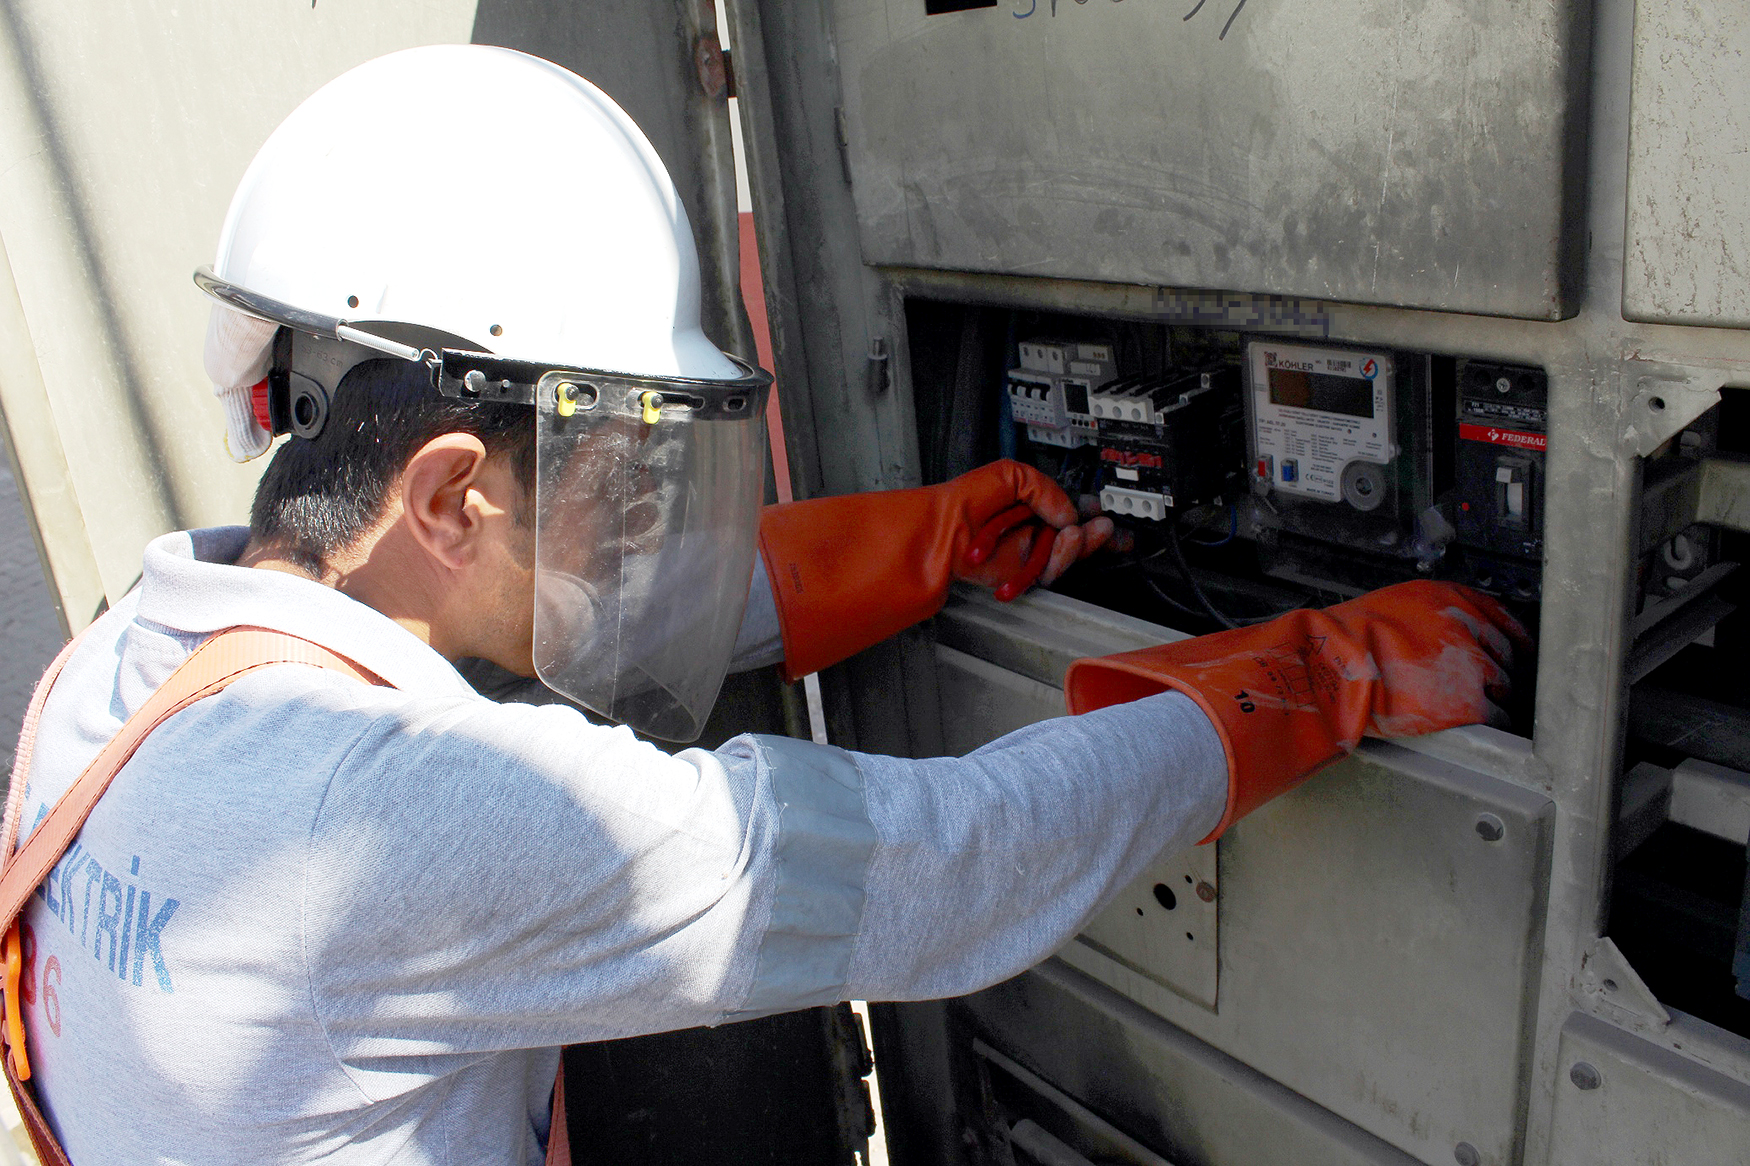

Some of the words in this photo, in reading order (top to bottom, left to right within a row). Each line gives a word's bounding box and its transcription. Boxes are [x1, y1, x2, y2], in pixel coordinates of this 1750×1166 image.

[1278, 360, 1314, 371] KÖHLER
[1501, 433, 1546, 446] FEDERAL
[1234, 690, 1255, 713] 10
[36, 841, 181, 994] EKTRİK
